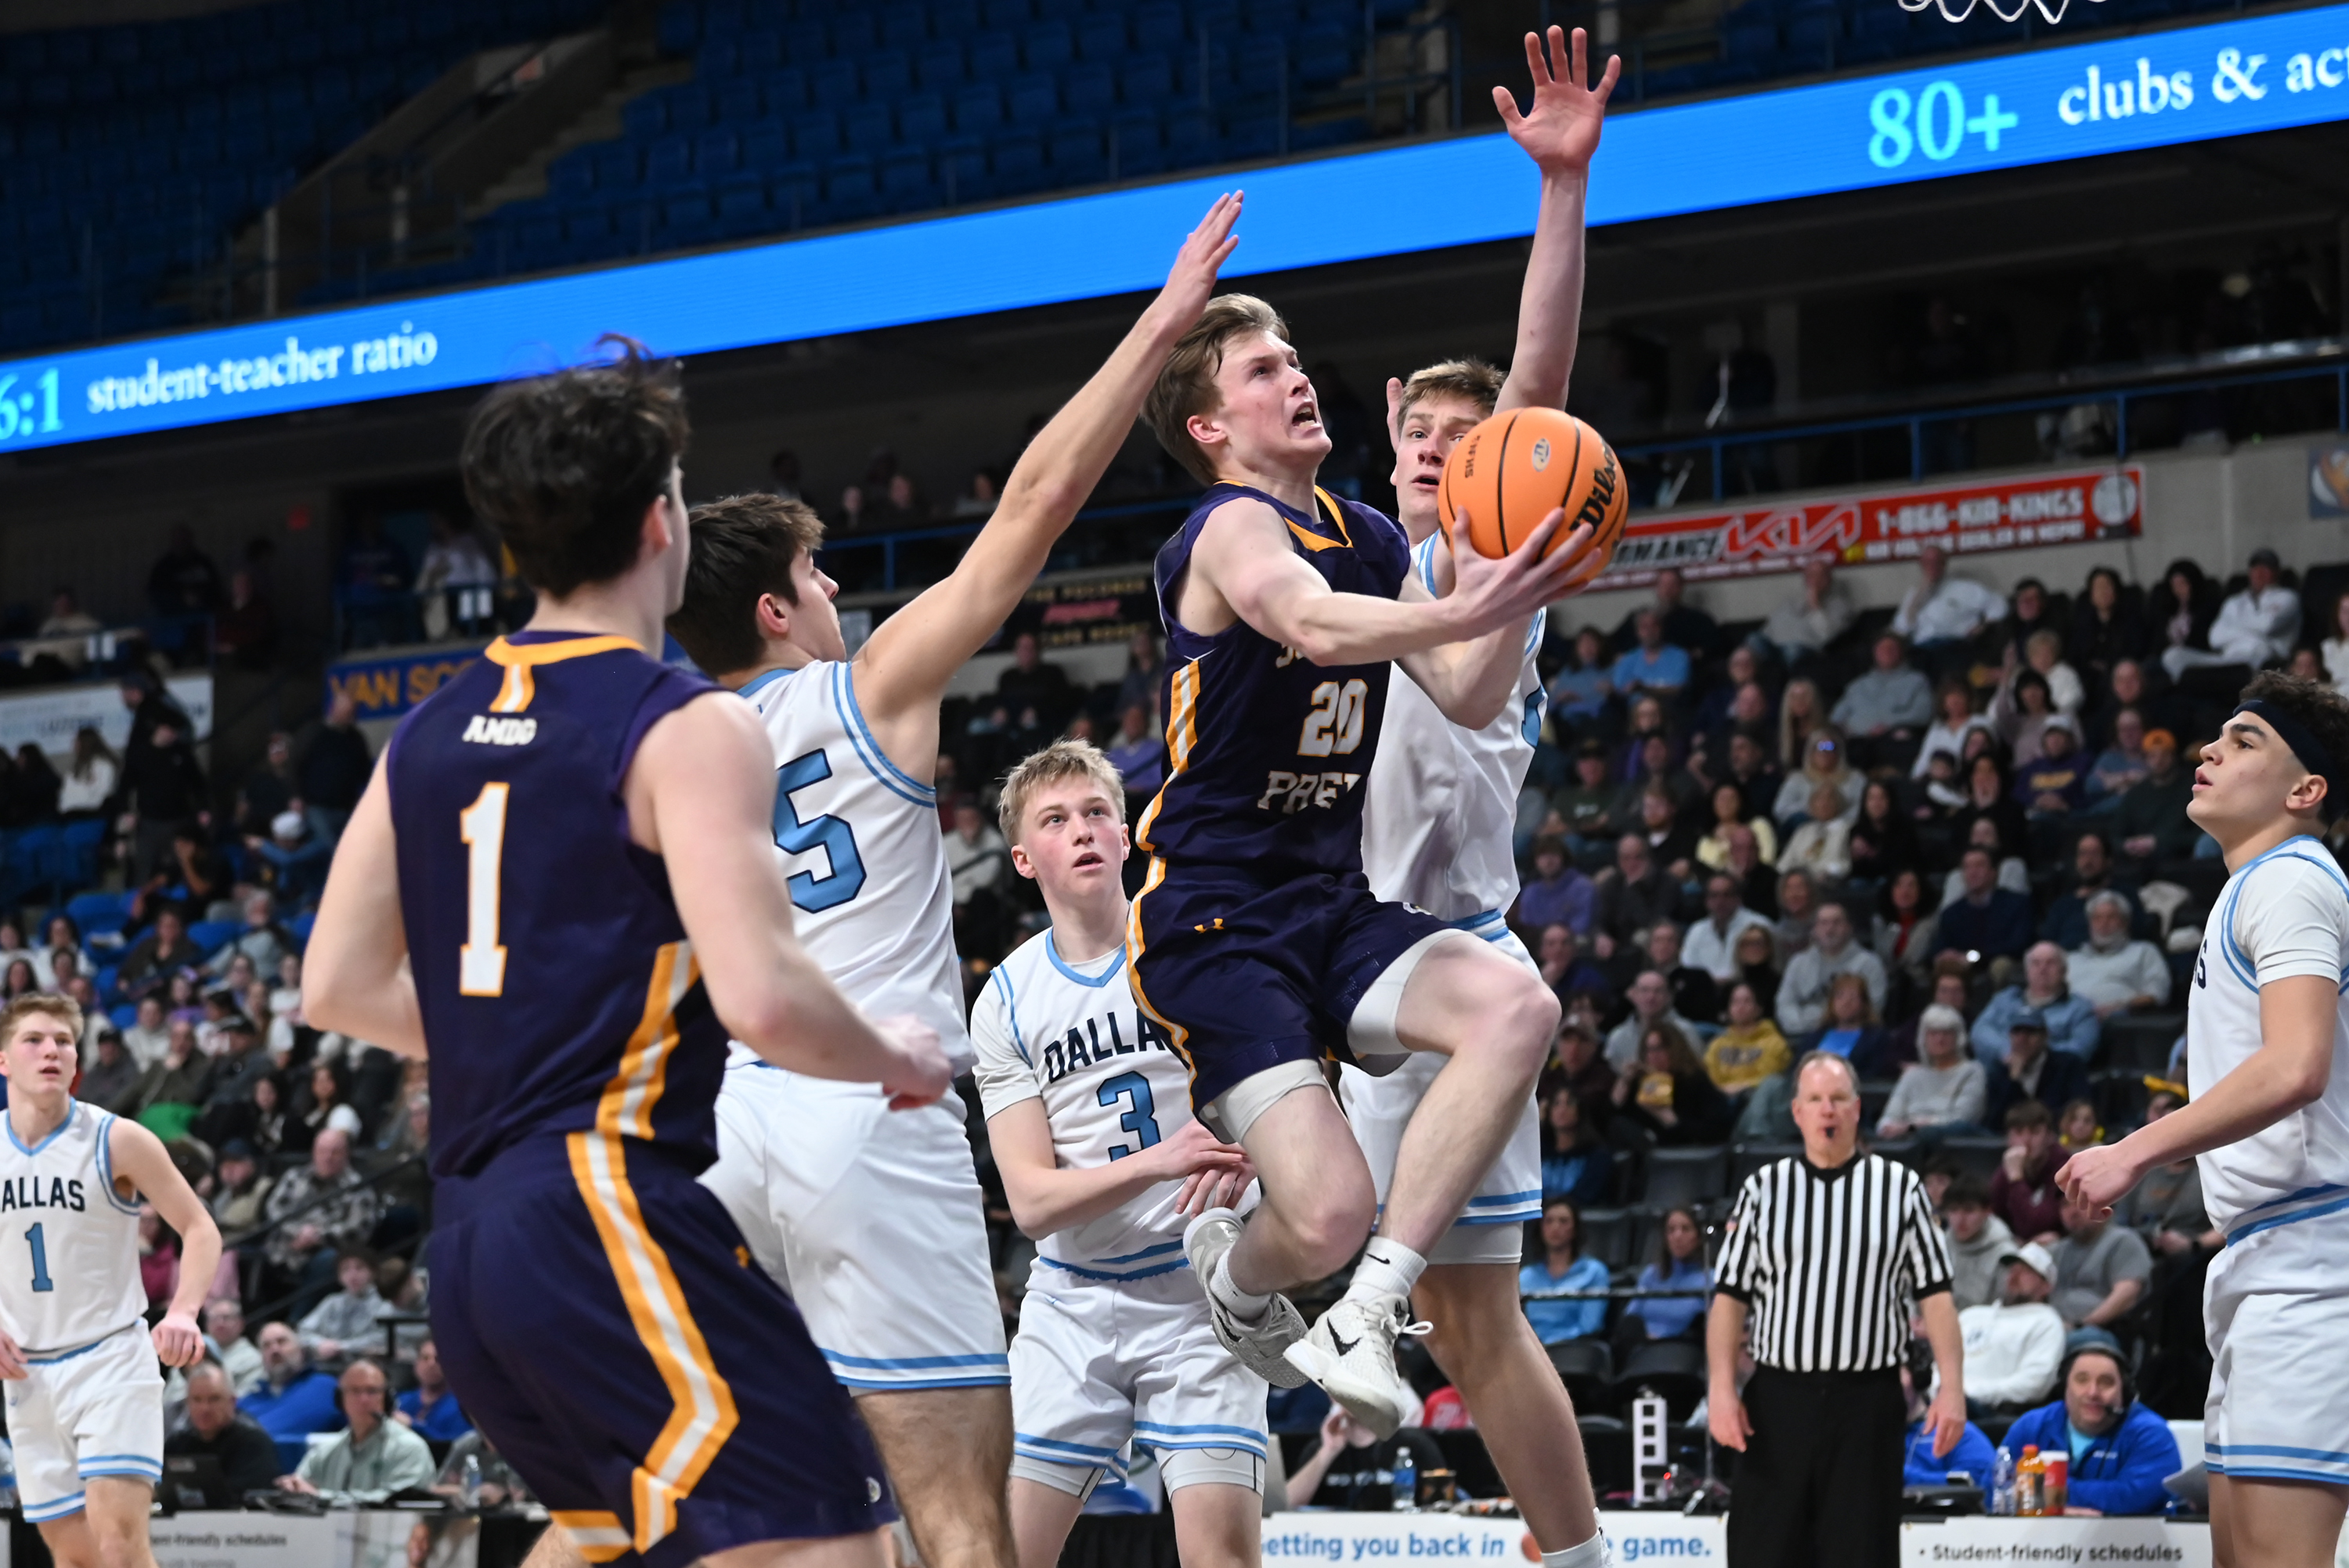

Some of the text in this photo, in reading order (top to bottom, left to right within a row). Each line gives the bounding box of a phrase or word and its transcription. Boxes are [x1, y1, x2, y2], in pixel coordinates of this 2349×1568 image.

[1869, 45, 2349, 168] 80+ clubs & ac
[87, 337, 345, 414] student-teacher
[351, 320, 438, 376] ratio
[1723, 503, 1862, 560] KIA
[406, 658, 474, 704] SC
[1297, 678, 1369, 758] 20
[772, 748, 867, 914] 5
[460, 782, 510, 997] 1
[1044, 1007, 1167, 1084] DALLA
[1096, 1070, 1162, 1162] 3
[0, 1176, 85, 1213] ALLAS
[24, 1221, 54, 1292] 1
[150, 1532, 287, 1548] ent-friendly schedules
[1351, 1537, 1400, 1563] you
[1409, 1532, 1471, 1556] back
[1481, 1532, 1505, 1555] in
[1622, 1536, 1712, 1562] game.
[1932, 1544, 2183, 1563] Student-friendly schedules
